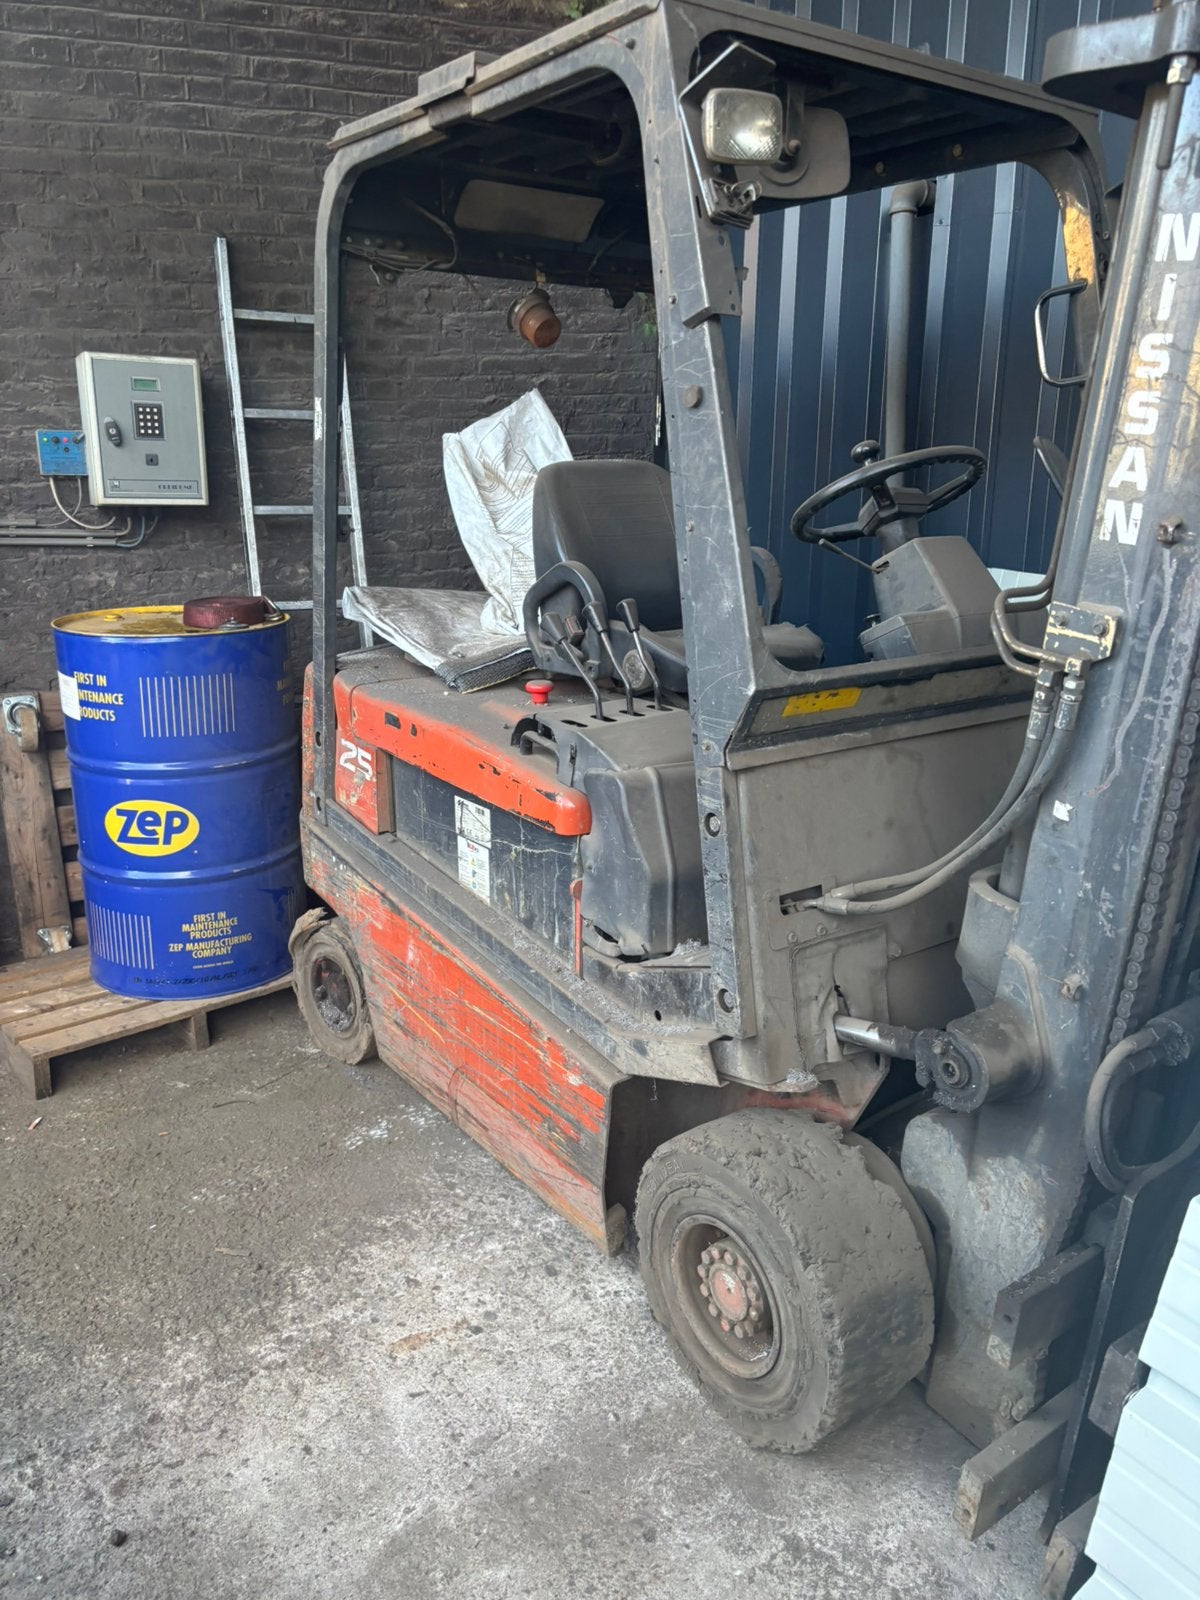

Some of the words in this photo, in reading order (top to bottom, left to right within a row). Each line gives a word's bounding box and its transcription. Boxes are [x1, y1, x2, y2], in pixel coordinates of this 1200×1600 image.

[1099, 212, 1200, 546] NISSAN
[74, 671, 94, 685] FIRST
[96, 674, 107, 687] IN
[78, 689, 124, 705] NTENANCE
[340, 738, 373, 781] 25
[182, 917, 238, 932] MAINTENANCE
[194, 912, 215, 923] FIRST
[217, 911, 226, 920] IN
[190, 926, 232, 940] PRODUCTS
[168, 943, 184, 952] ZEP
[185, 932, 253, 951] MANUFACTURING
[192, 946, 232, 959] COMPANY
